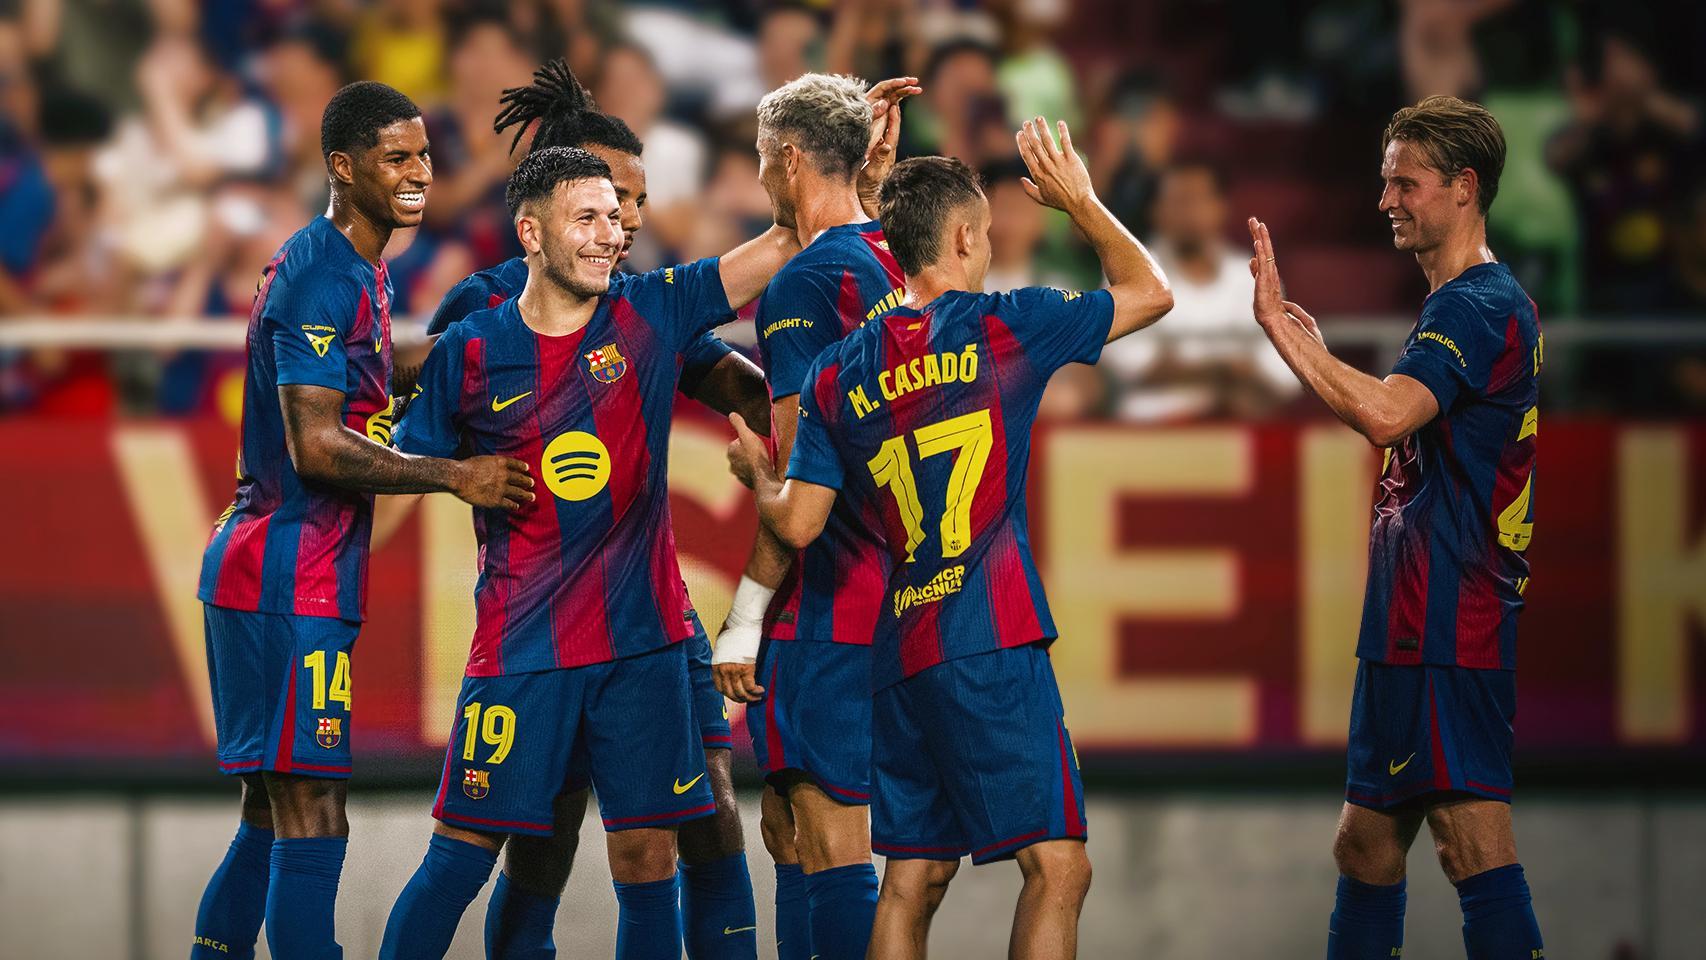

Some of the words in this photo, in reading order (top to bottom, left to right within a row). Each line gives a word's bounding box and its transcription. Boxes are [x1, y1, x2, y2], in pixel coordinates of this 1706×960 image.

[803, 319, 814, 328] tv
[1418, 331, 1462, 358] AMBILIGHT
[848, 384, 881, 420] M.
[878, 343, 978, 401] CASADÓ
[866, 408, 993, 563] 17
[303, 650, 351, 711] 14
[463, 702, 517, 765] 19
